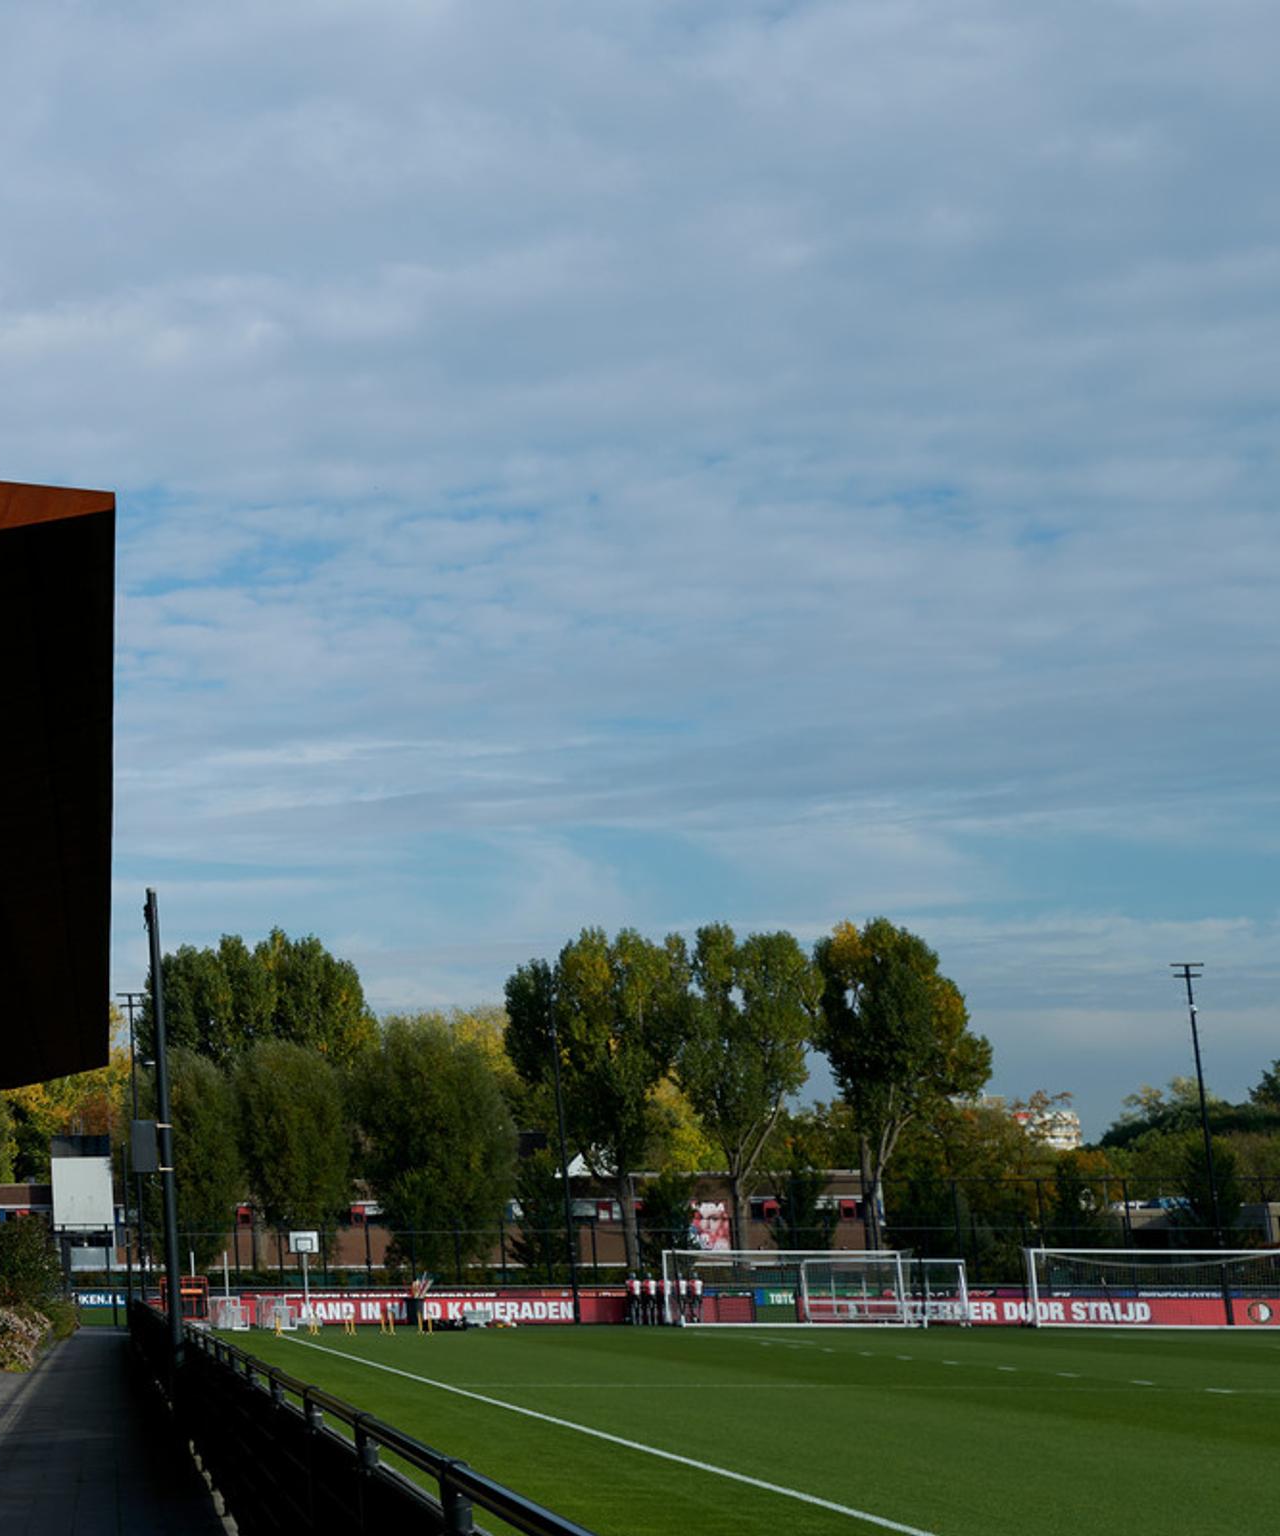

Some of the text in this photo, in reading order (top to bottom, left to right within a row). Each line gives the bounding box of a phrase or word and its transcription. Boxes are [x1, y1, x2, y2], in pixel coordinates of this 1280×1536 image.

[360, 1301, 381, 1320] IN
[386, 1301, 441, 1320] HD
[1072, 1301, 1151, 1321] STRIJD
